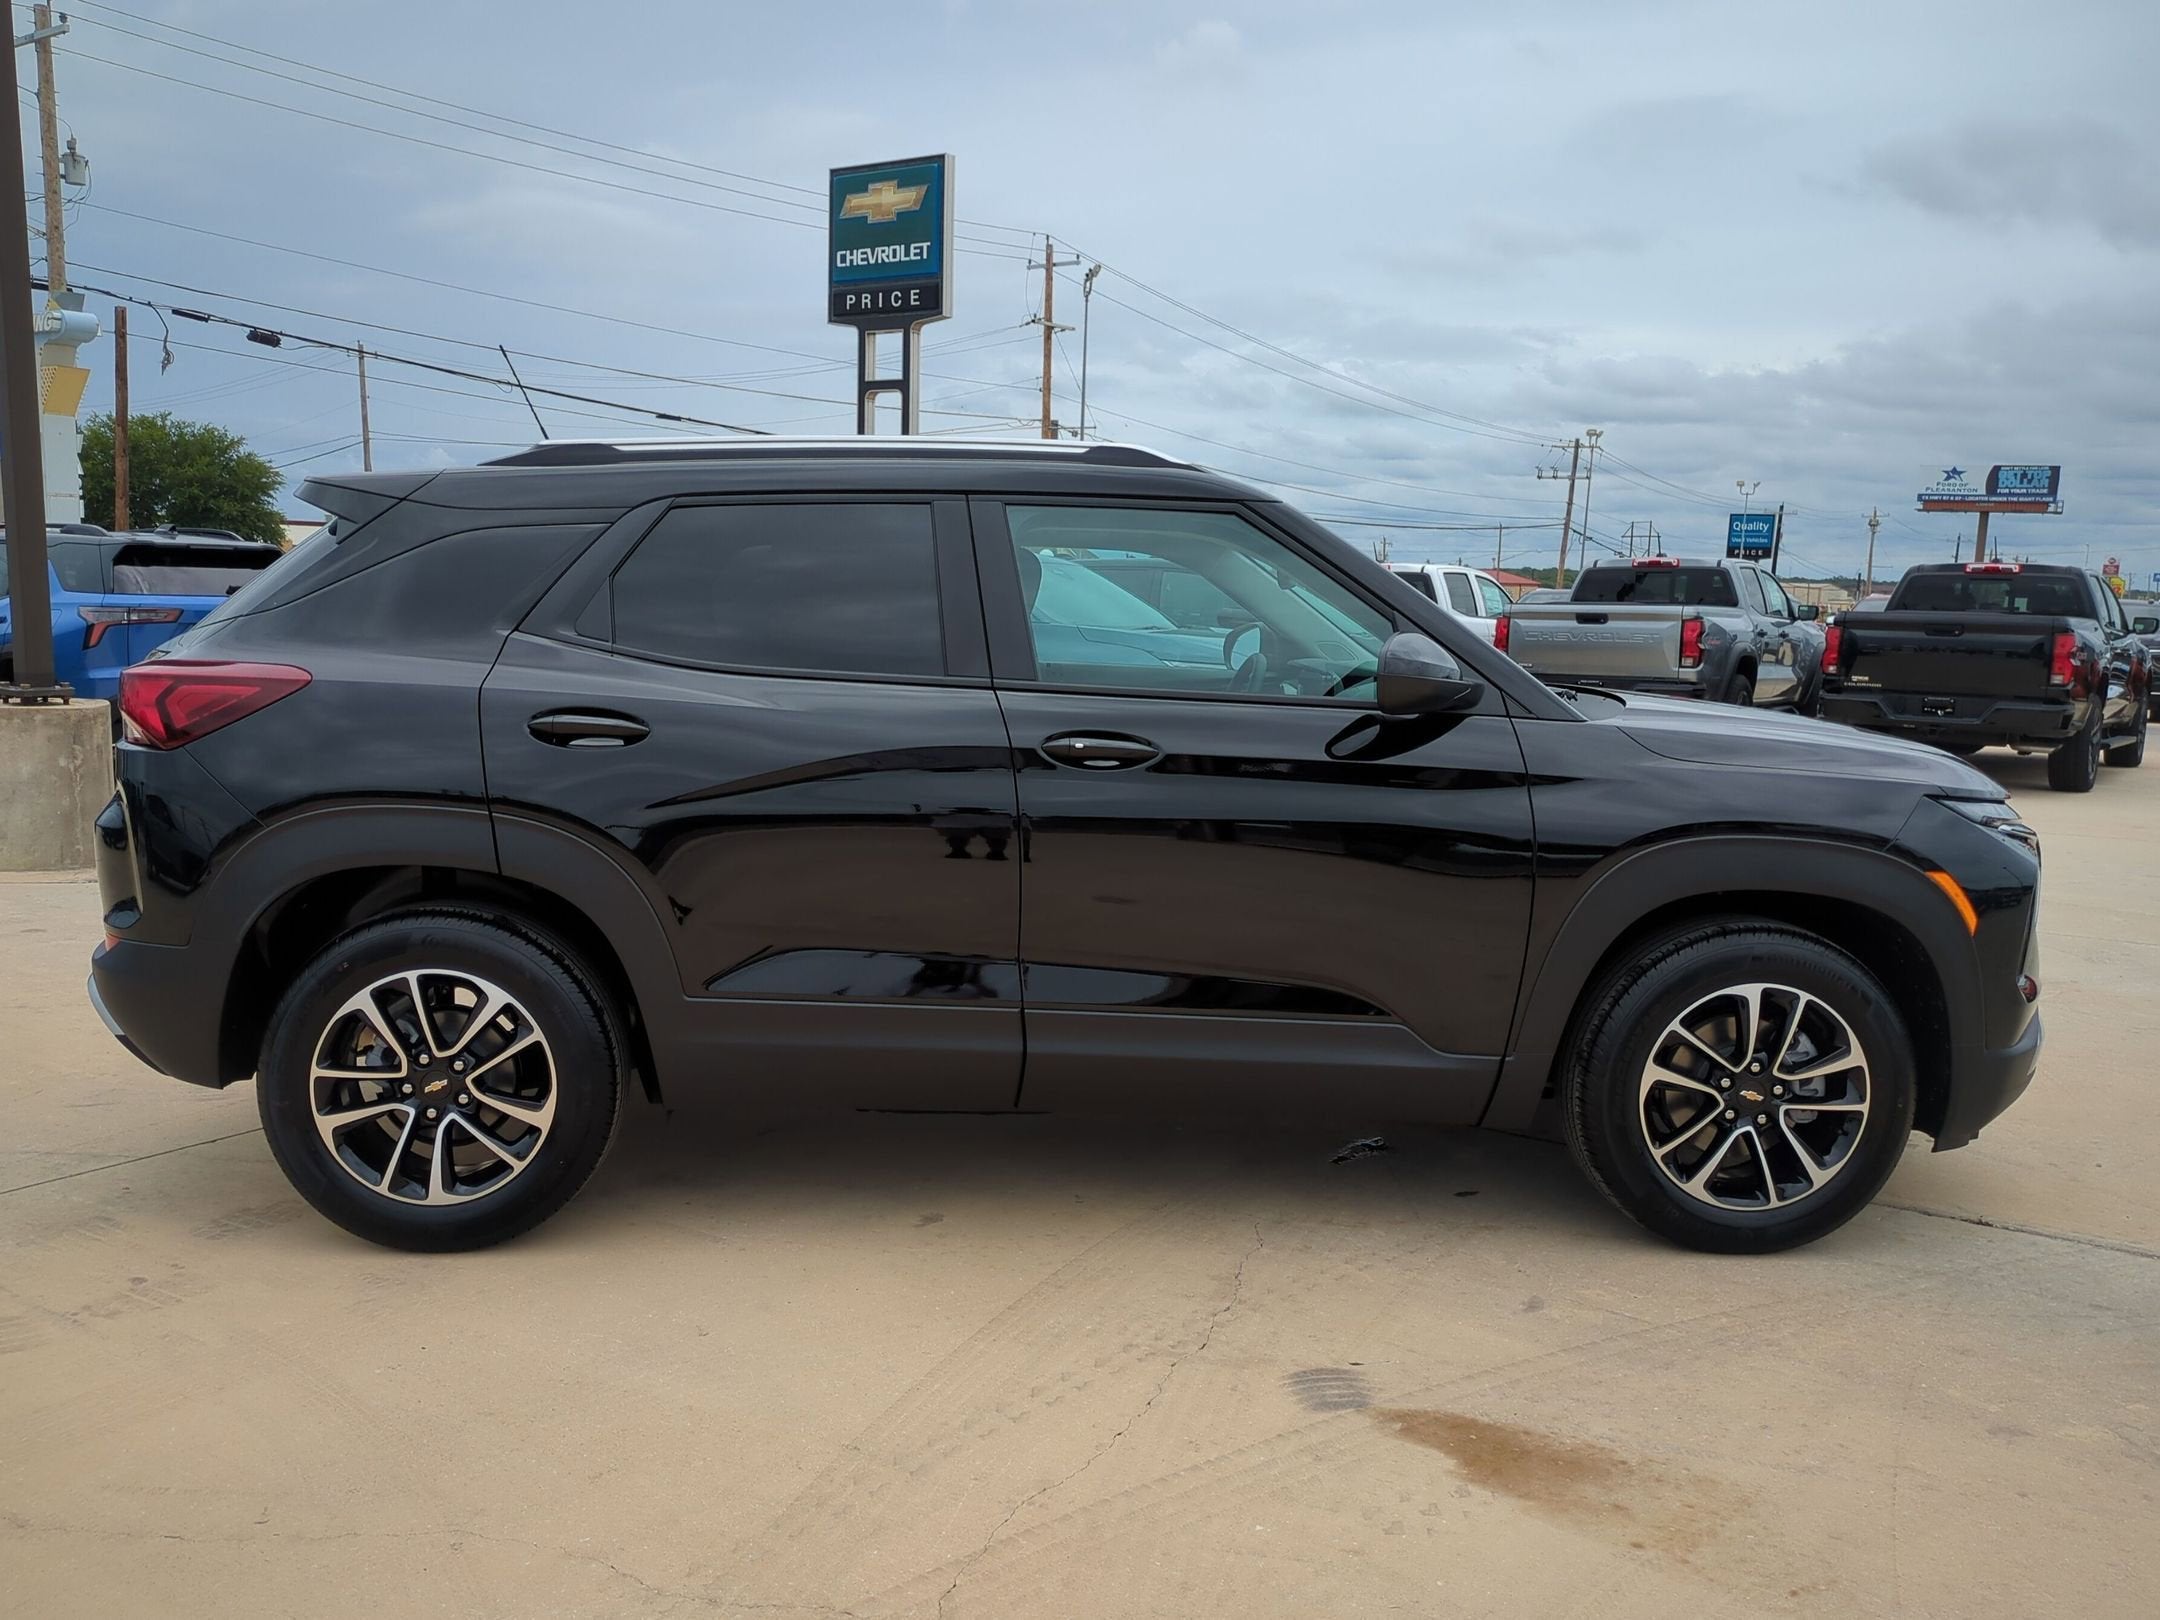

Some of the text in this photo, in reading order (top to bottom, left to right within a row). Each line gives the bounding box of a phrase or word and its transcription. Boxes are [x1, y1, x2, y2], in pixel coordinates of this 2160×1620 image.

[836, 241, 931, 268] CHEVROLET
[846, 289, 920, 310] PRICE
[1733, 521, 1769, 532] Quality
[1525, 630, 1660, 643] CHEVROLET
